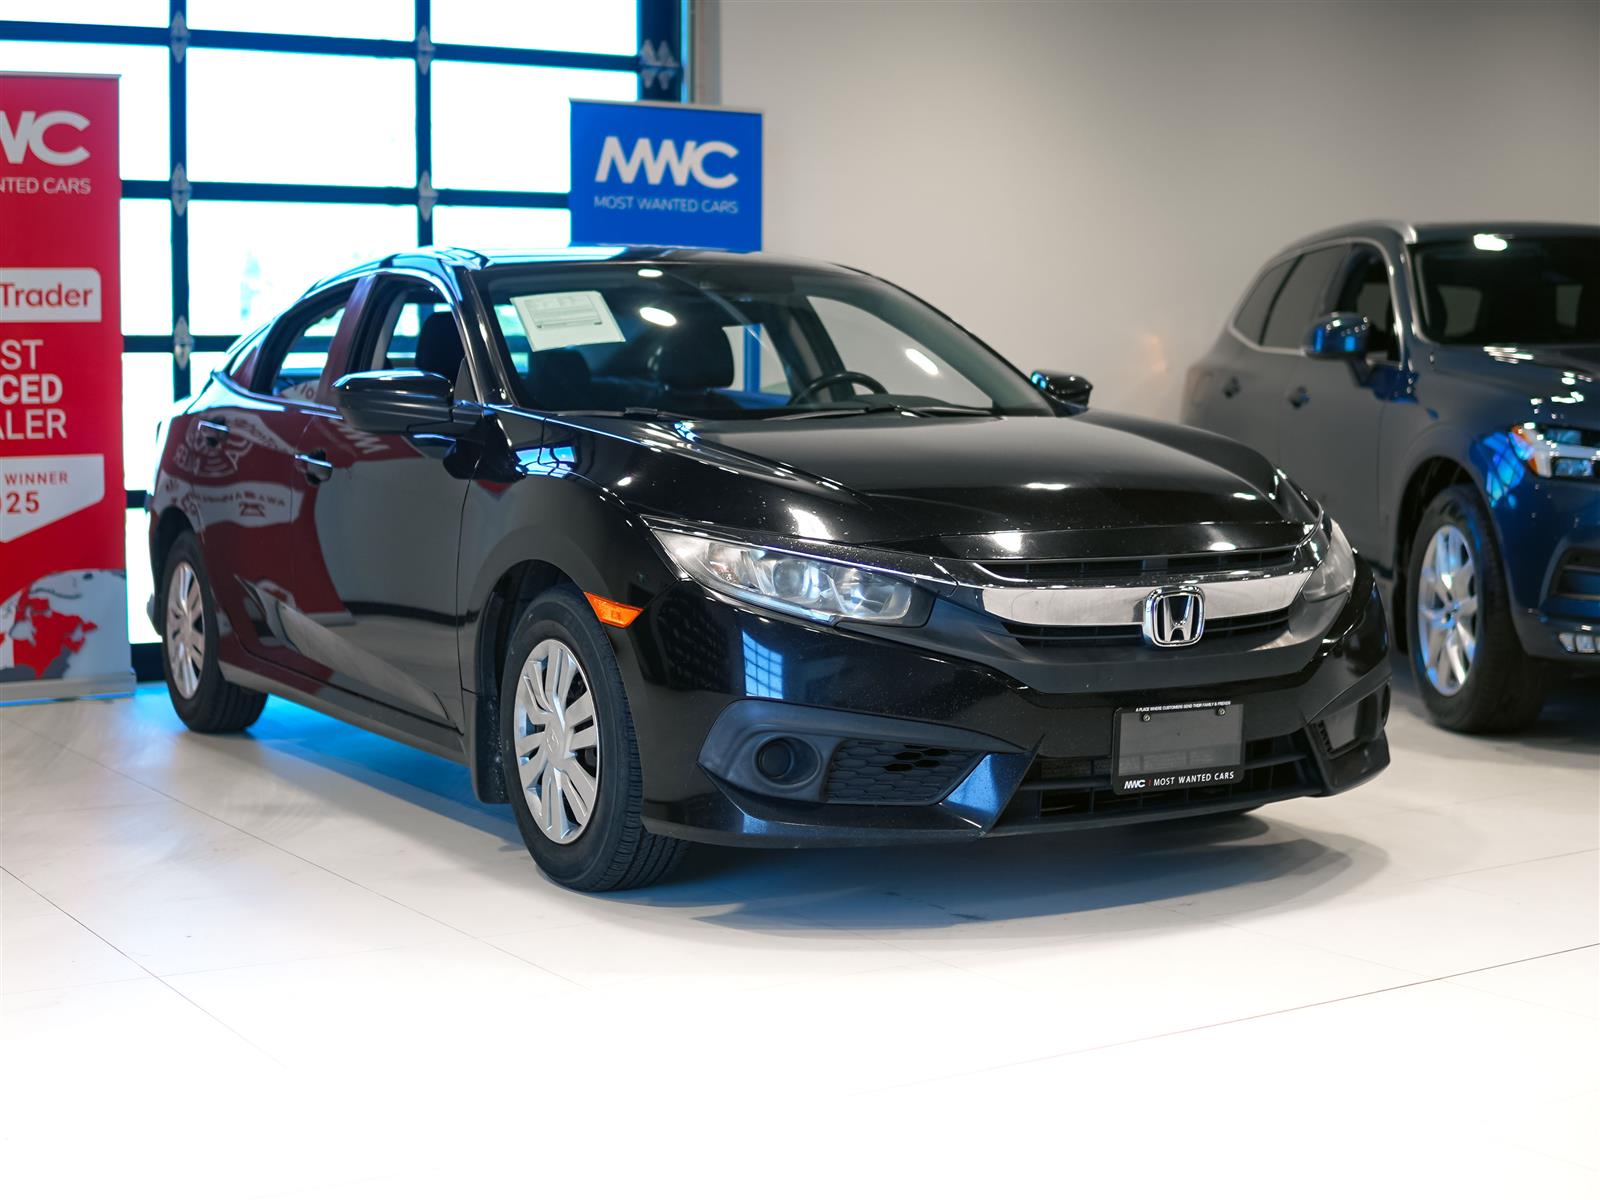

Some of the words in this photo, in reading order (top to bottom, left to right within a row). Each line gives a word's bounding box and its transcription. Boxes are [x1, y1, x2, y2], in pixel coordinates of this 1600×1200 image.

[595, 135, 739, 189] MWC
[43, 178, 91, 195] CARS
[594, 196, 634, 209] MOST
[638, 198, 698, 213] WANTED
[701, 200, 738, 214] CARS
[4, 471, 68, 486] WINNER
[0, 491, 40, 514] 25
[1153, 776, 1175, 787] MOST
[1178, 773, 1212, 784] WANTED
[1214, 771, 1235, 781] CARS
